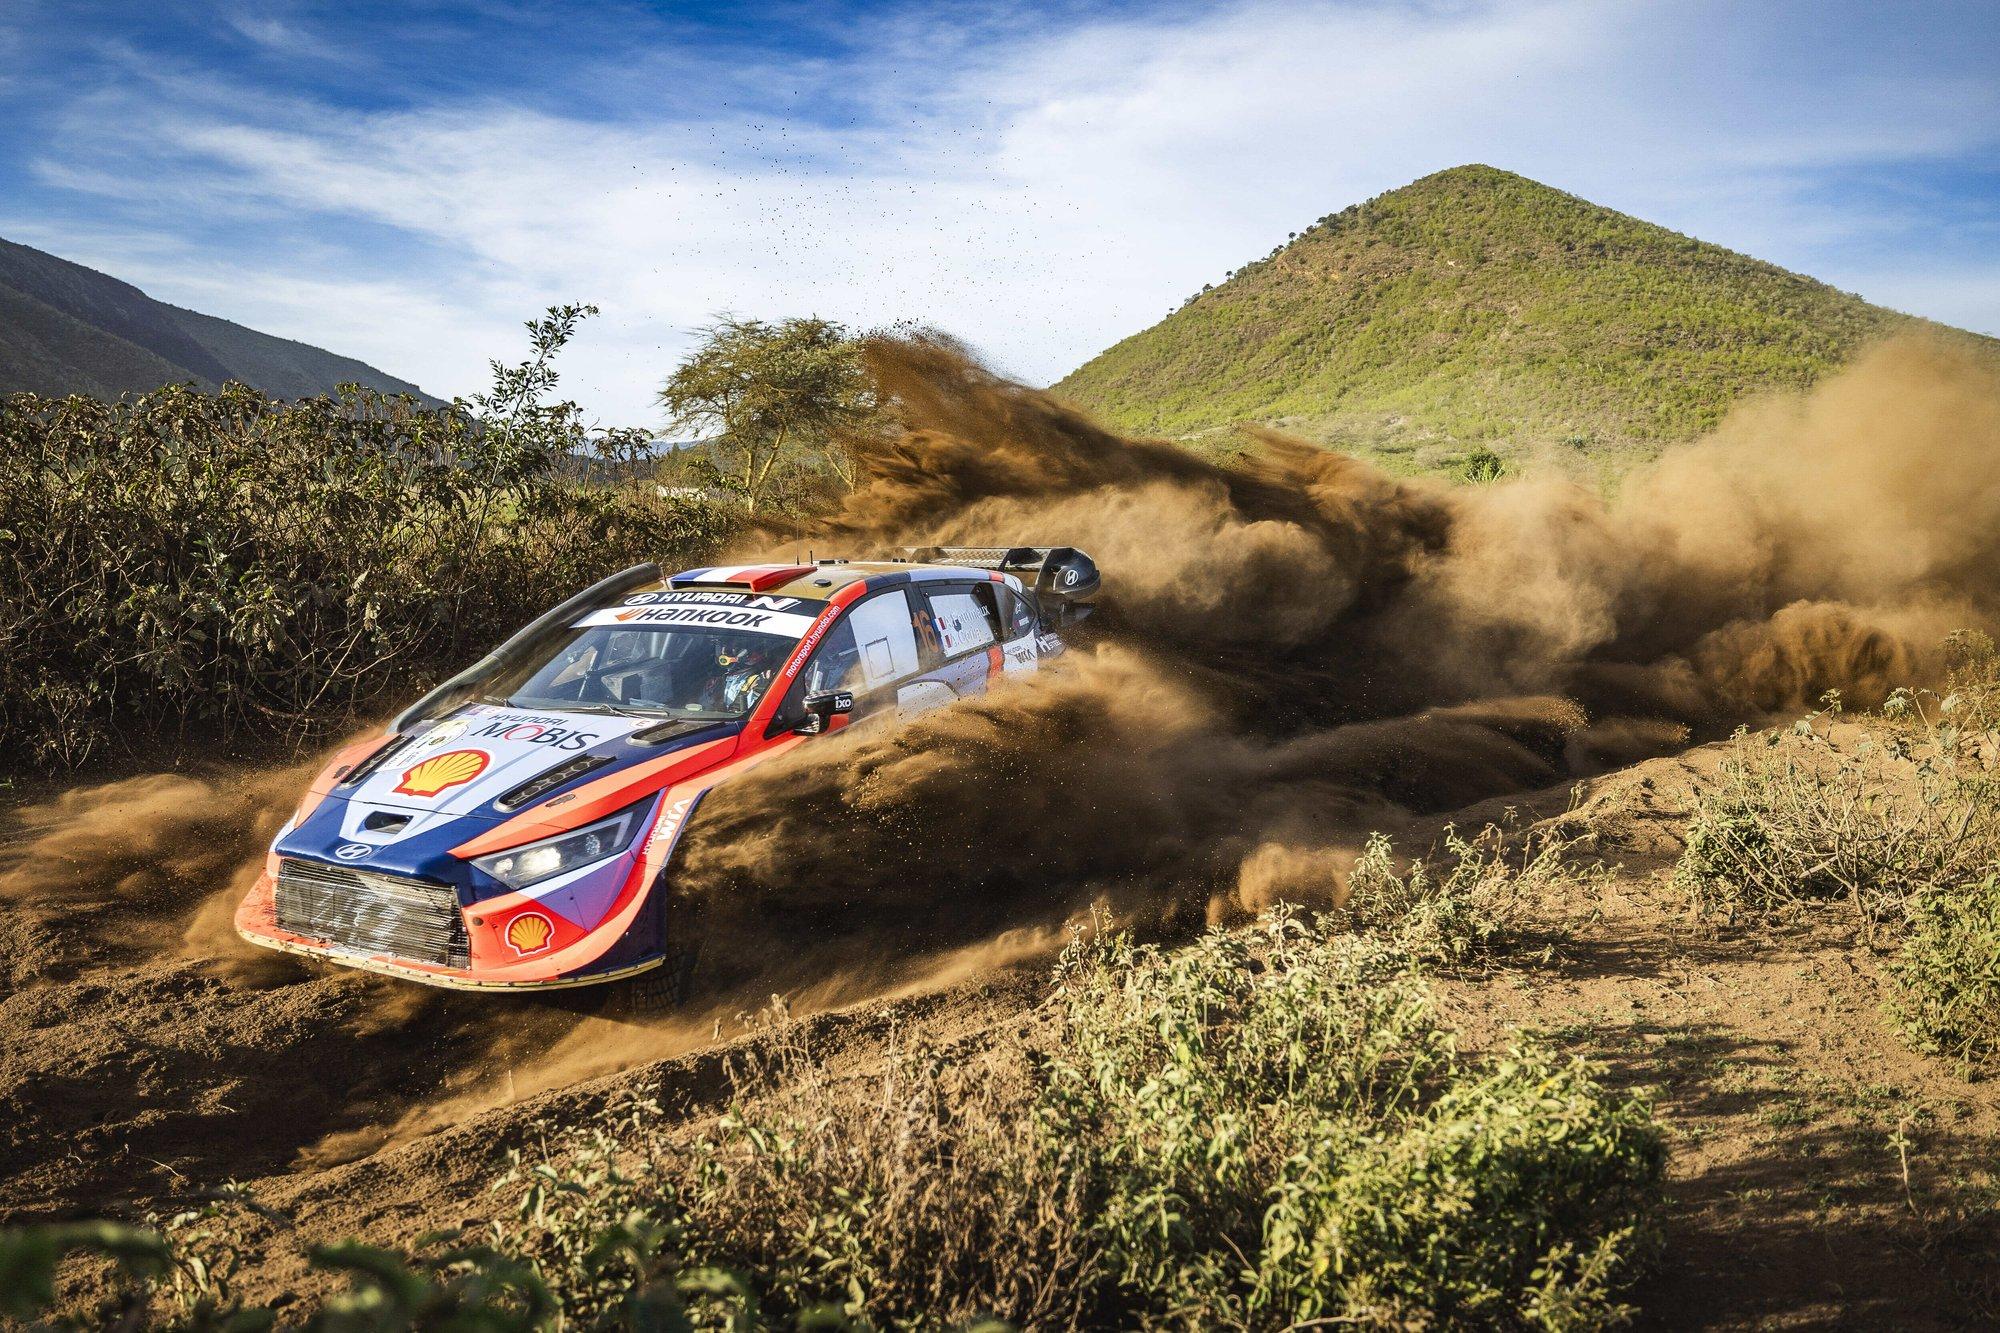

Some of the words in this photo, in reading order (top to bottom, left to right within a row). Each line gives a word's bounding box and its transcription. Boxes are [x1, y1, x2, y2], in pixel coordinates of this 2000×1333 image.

[657, 593, 747, 605] HYUNDAI
[785, 605, 841, 678] motorsport.hyundai.com
[912, 608, 939, 652] 16
[488, 714, 569, 725] HYUNDAI
[469, 722, 599, 750] MOBIS
